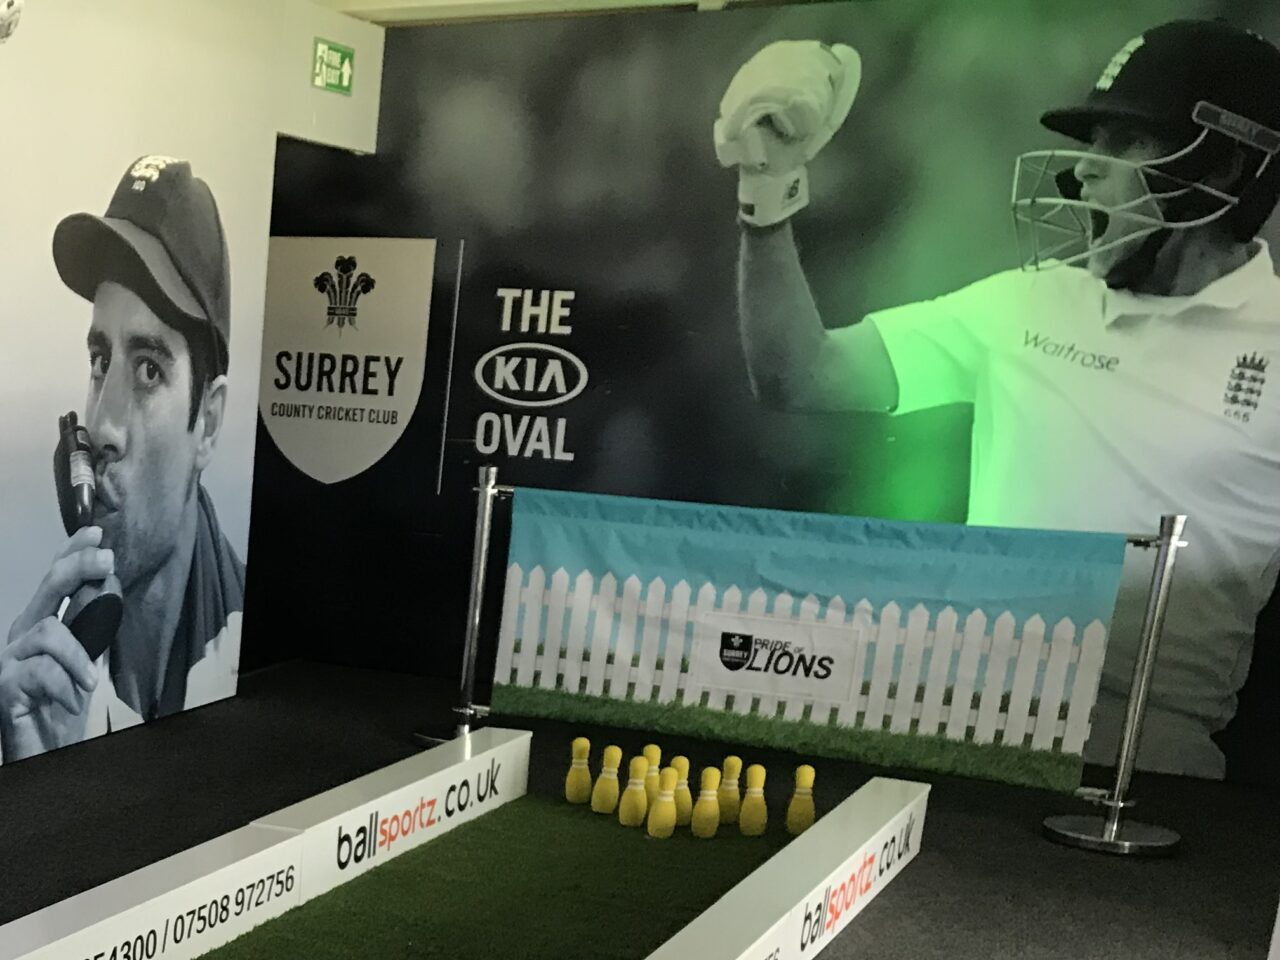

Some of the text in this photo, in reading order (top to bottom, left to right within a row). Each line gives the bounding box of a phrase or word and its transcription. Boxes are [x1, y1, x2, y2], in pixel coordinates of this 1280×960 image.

[497, 288, 575, 335] THE
[274, 350, 404, 396] SURREY
[1023, 329, 1120, 372] Waitrose
[493, 355, 567, 394] KIA
[271, 402, 399, 425] COUNTY CRICKET CLUB
[475, 412, 575, 461] OVAL
[745, 648, 835, 680] LIONS
[754, 638, 792, 652] PRIDE
[336, 757, 501, 870] ballsportz.co.uk
[173, 894, 231, 946] 07508
[234, 864, 296, 917] 972756
[800, 811, 916, 953] ballsportz.co.uk
